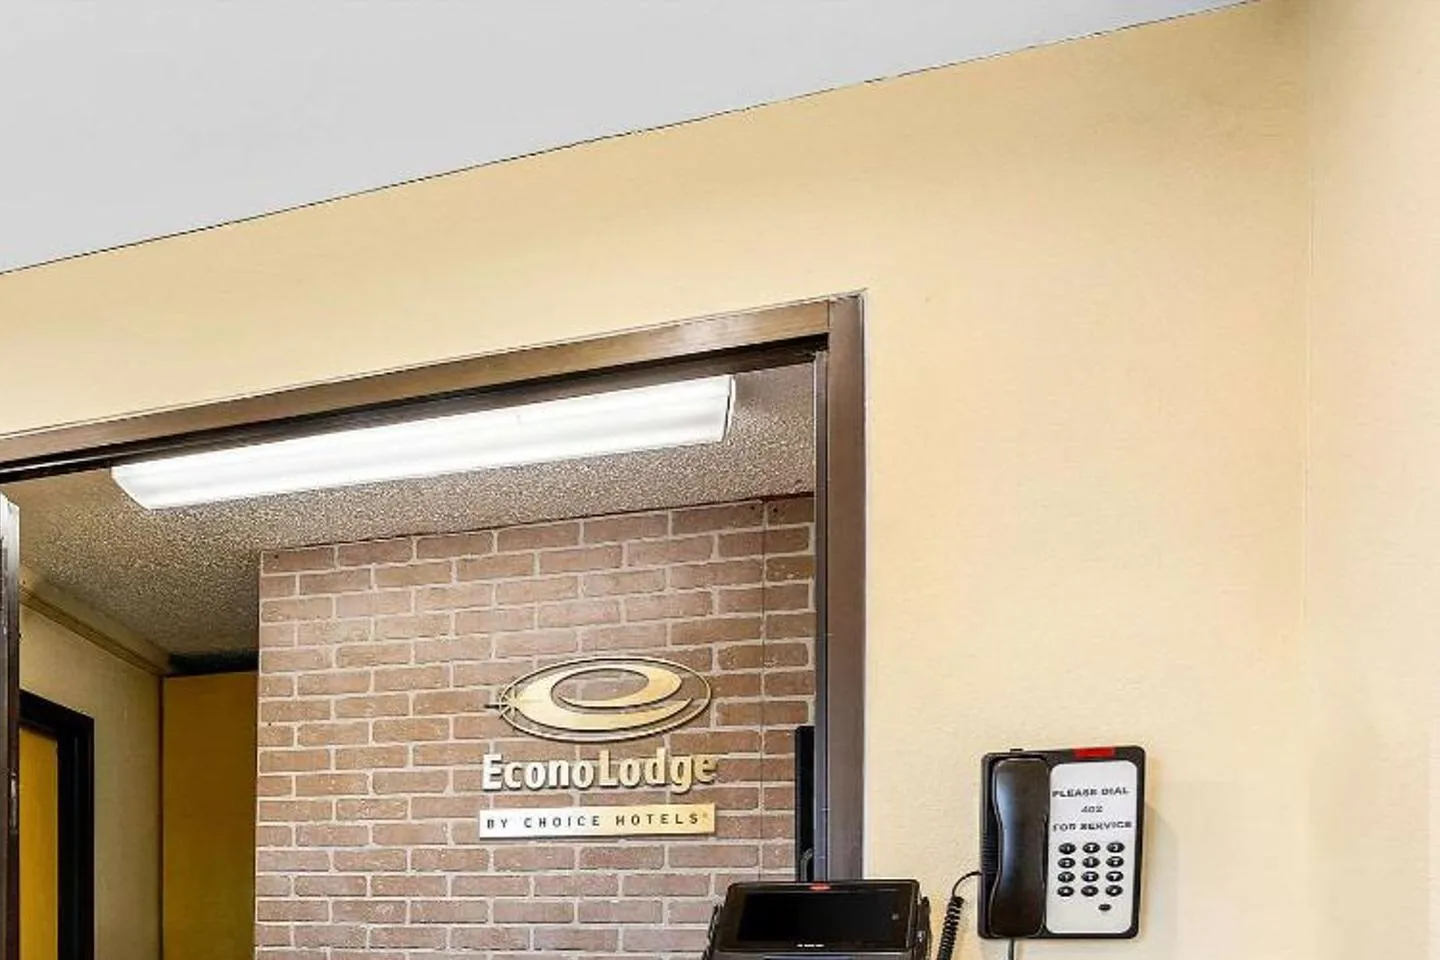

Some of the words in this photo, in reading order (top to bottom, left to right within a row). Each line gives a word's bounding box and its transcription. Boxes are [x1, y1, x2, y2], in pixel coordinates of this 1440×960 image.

[481, 748, 718, 794] EconoLodge
[1051, 788, 1098, 797] PLEASE
[1101, 787, 1130, 796] DIAL
[486, 818, 509, 830] BY
[523, 815, 601, 829] CHOICE
[1052, 823, 1076, 832] FOR
[1080, 821, 1132, 830] SERVICE
